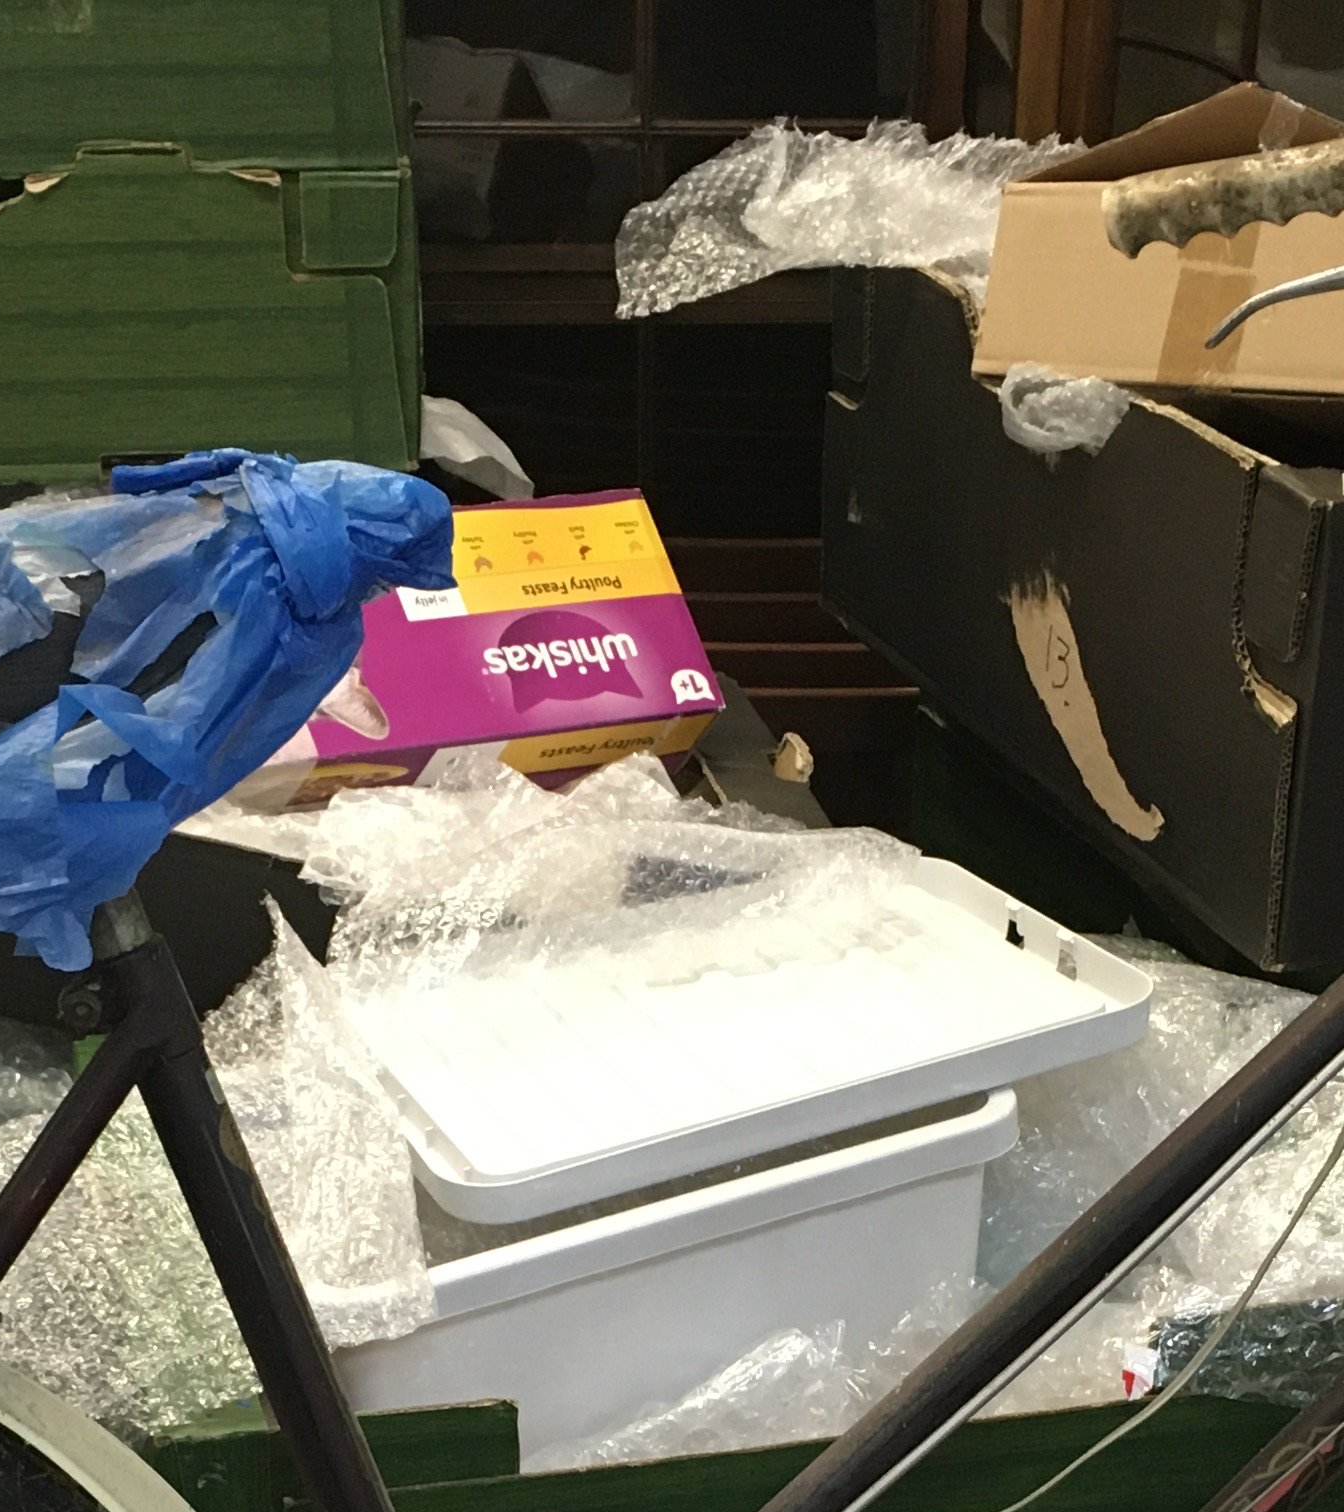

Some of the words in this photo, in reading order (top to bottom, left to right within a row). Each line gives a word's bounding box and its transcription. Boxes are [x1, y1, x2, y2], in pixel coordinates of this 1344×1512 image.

[522, 580, 569, 596] Feasts
[569, 575, 622, 592] Poultry
[415, 594, 437, 607] jelly
[439, 596, 448, 604] in
[482, 633, 639, 679] whiskas
[679, 673, 704, 694] 1+
[538, 743, 596, 759] Feasts
